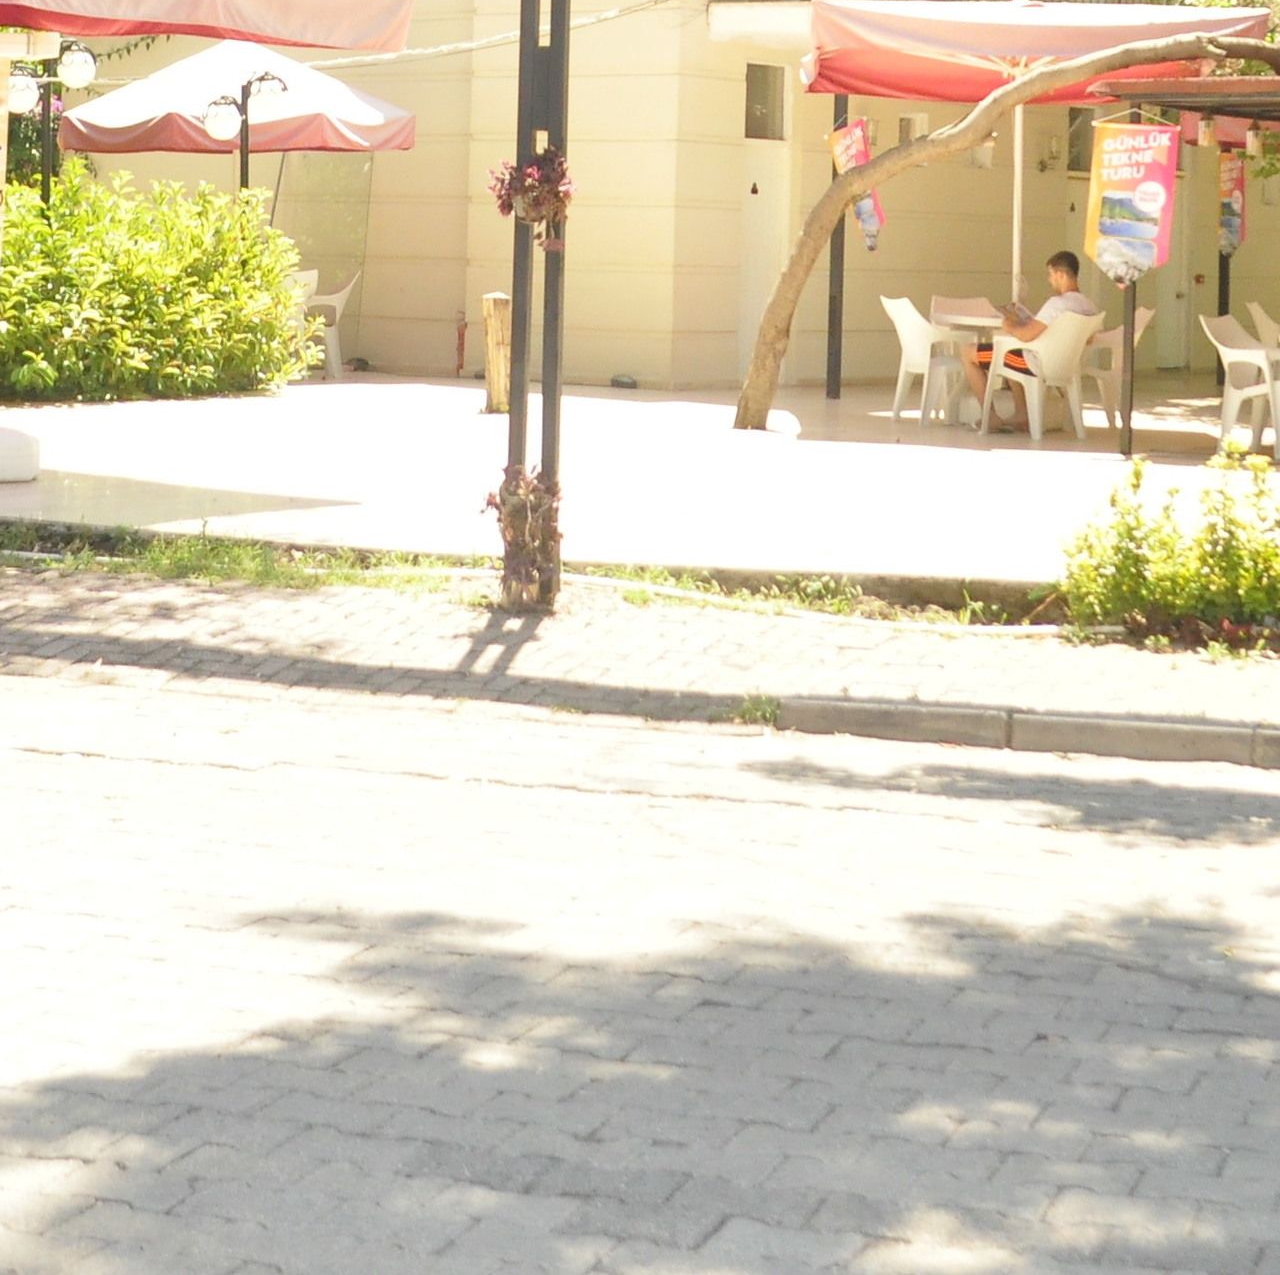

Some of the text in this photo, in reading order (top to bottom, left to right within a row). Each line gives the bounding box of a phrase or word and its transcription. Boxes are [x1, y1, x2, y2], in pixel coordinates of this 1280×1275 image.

[1102, 131, 1171, 152] GÜNLÜK
[1101, 149, 1153, 166] TEKNE
[1100, 165, 1145, 182] TURU
